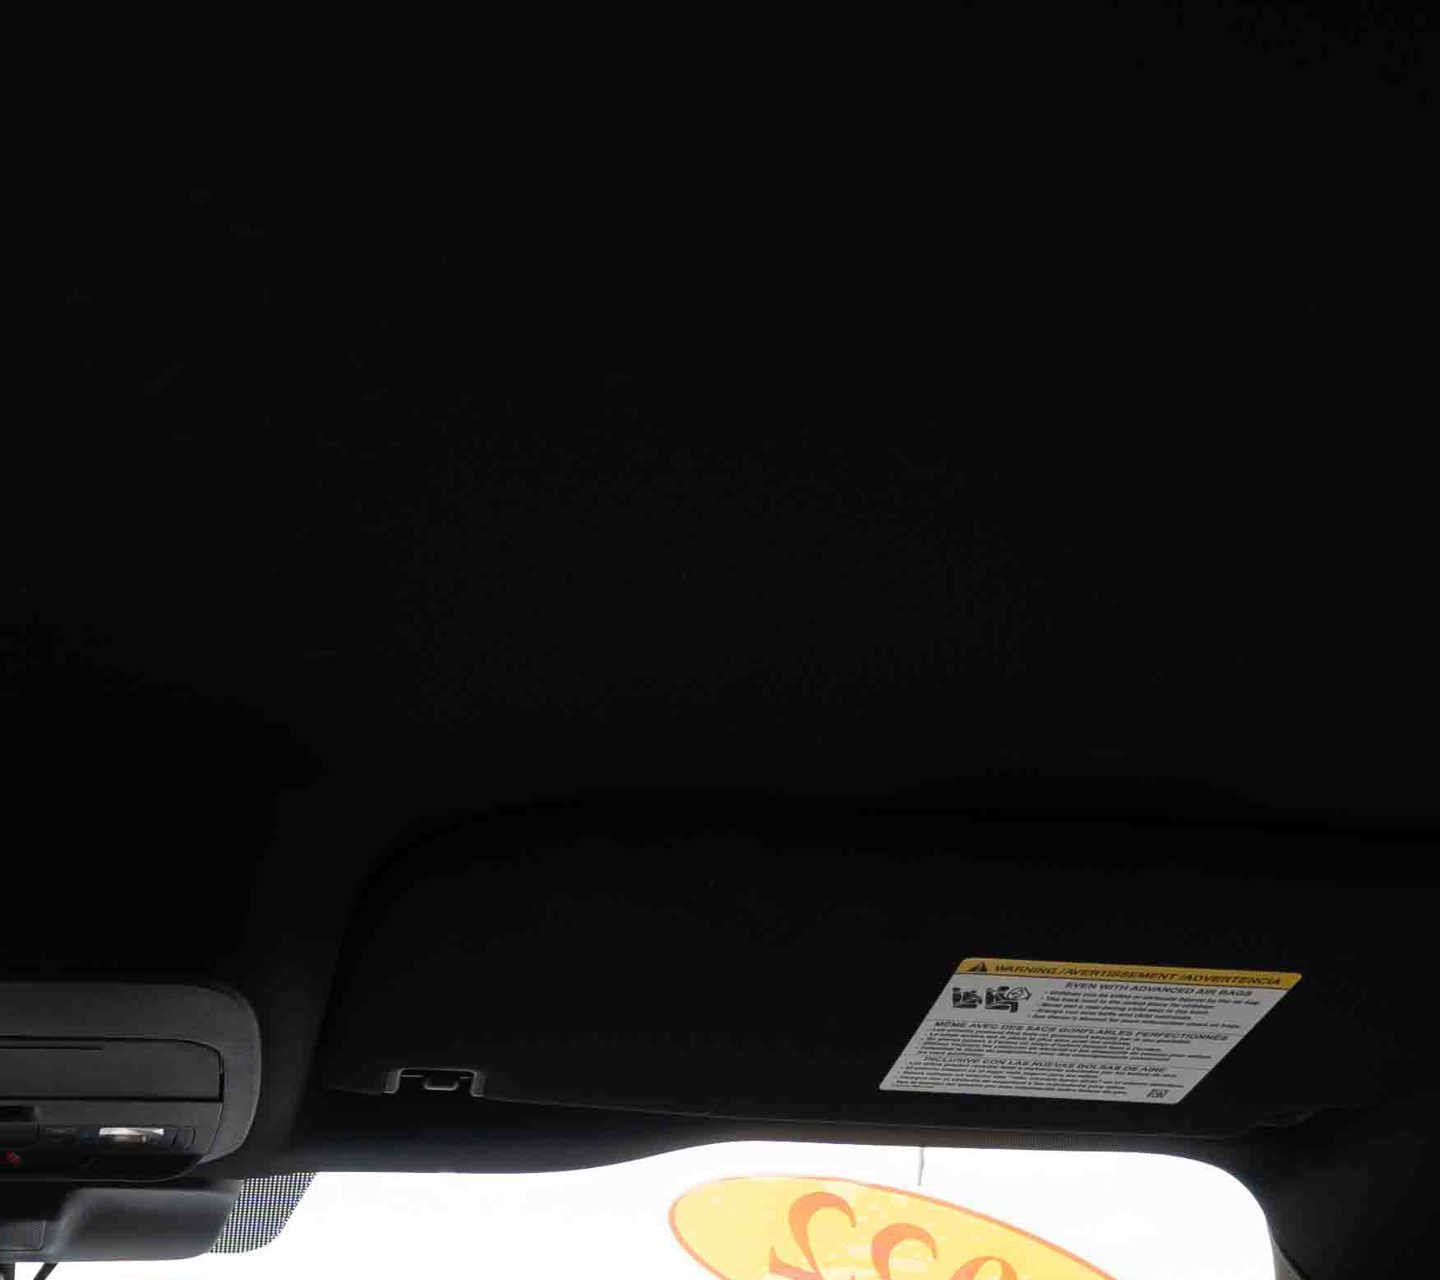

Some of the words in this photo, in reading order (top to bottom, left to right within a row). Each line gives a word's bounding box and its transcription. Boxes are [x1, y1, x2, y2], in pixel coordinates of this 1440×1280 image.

[993, 963, 1056, 977] WARNING
[1065, 982, 1099, 991] EVEN
[1100, 983, 1131, 993] WITH
[1131, 984, 1195, 995] ADVANCED
[1196, 987, 1217, 996] AIR
[1218, 987, 1253, 998] BAGS
